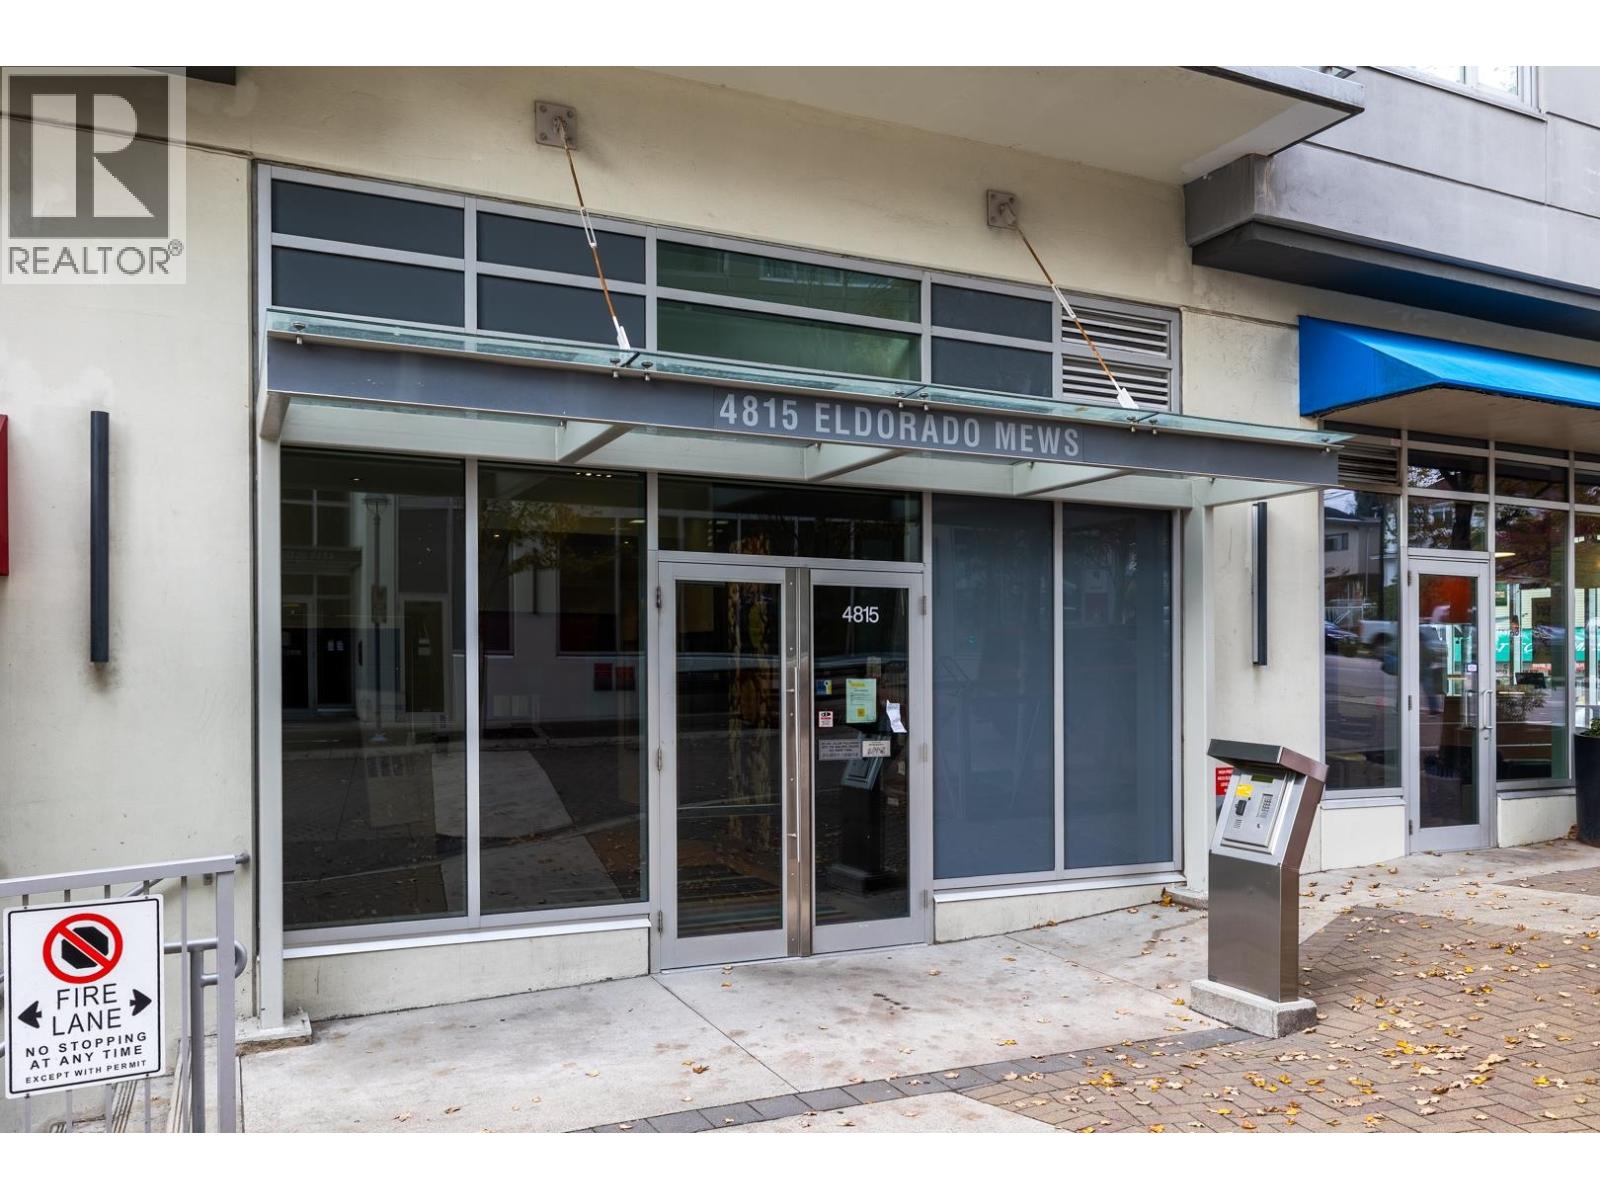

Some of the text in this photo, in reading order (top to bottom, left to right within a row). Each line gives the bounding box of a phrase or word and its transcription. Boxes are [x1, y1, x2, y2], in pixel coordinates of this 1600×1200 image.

[719, 393, 1081, 457] 4815 ELDORADO MEWS
[842, 605, 879, 623] 4815
[57, 983, 117, 1009] FIRE
[52, 1008, 121, 1036] LANE
[25, 1032, 147, 1058] NO STOPPING
[30, 1045, 143, 1070] AT ANY TIME
[26, 1060, 146, 1084] EXCEPT WITH PERMIT
